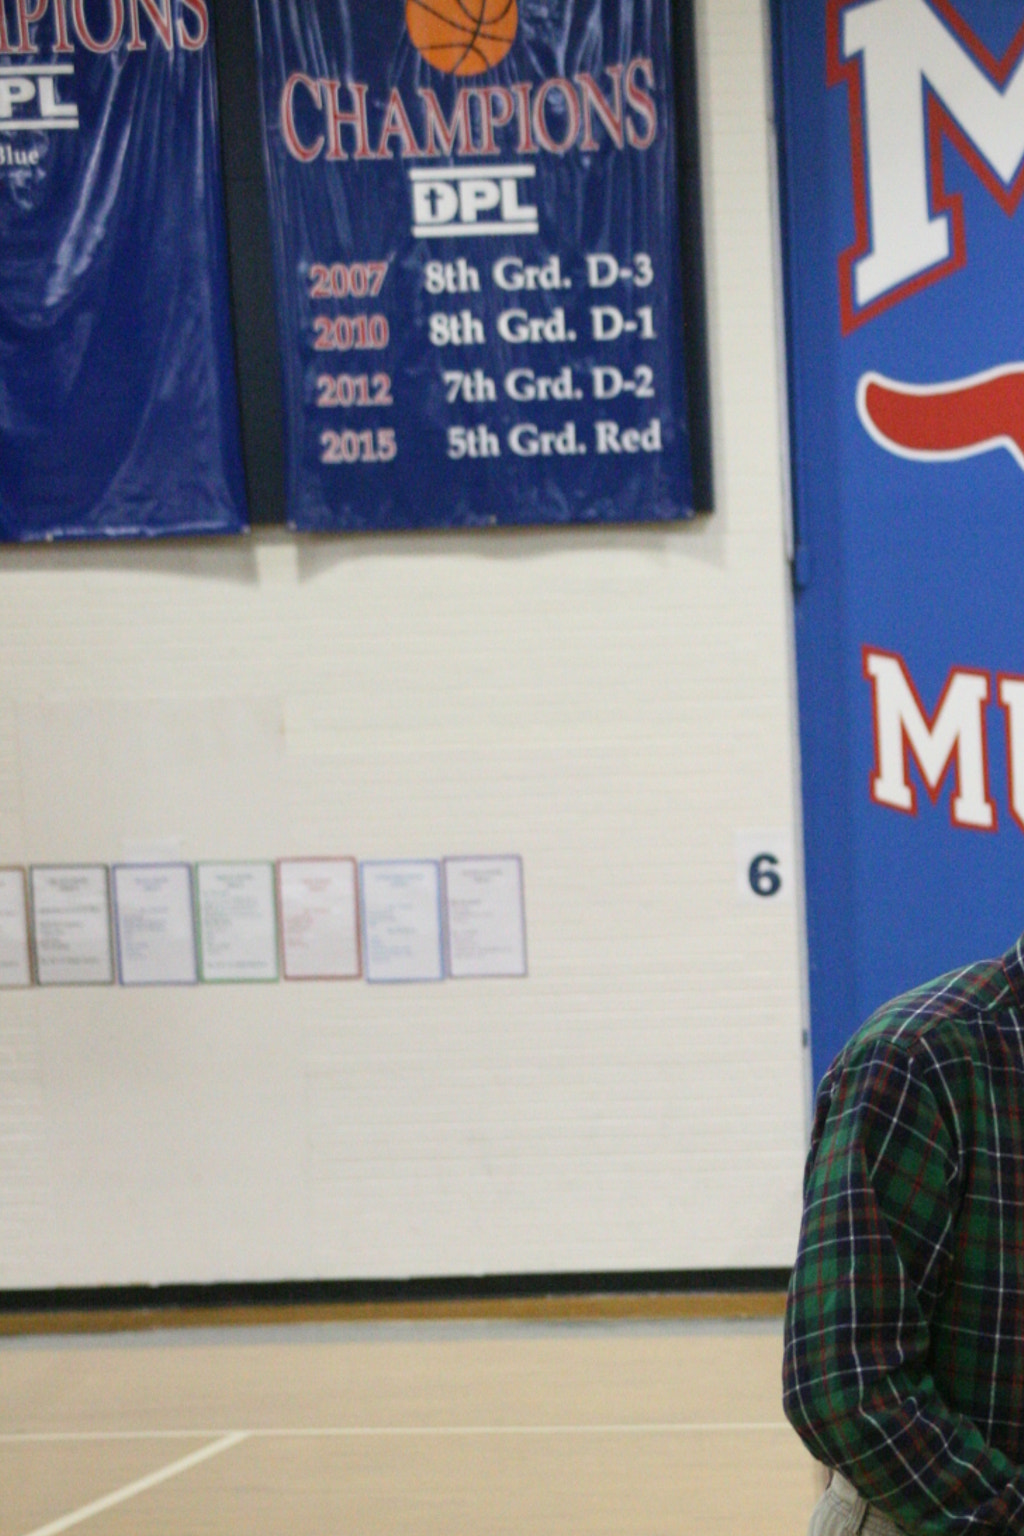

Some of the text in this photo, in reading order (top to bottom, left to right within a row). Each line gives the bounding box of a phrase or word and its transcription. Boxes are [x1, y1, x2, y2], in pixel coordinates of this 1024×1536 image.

[0, 0, 208, 53] PIONS
[282, 58, 657, 162] CHAMPIONS
[412, 178, 538, 224] DPL
[309, 253, 654, 298] 2007 8th Grd. D-3
[313, 306, 657, 351] 2010 8th Grd. D-1
[316, 365, 655, 407] 2012 7th Grd. D-2
[321, 419, 662, 463] 2015 5th Grd. Red
[749, 853, 781, 897] 6
